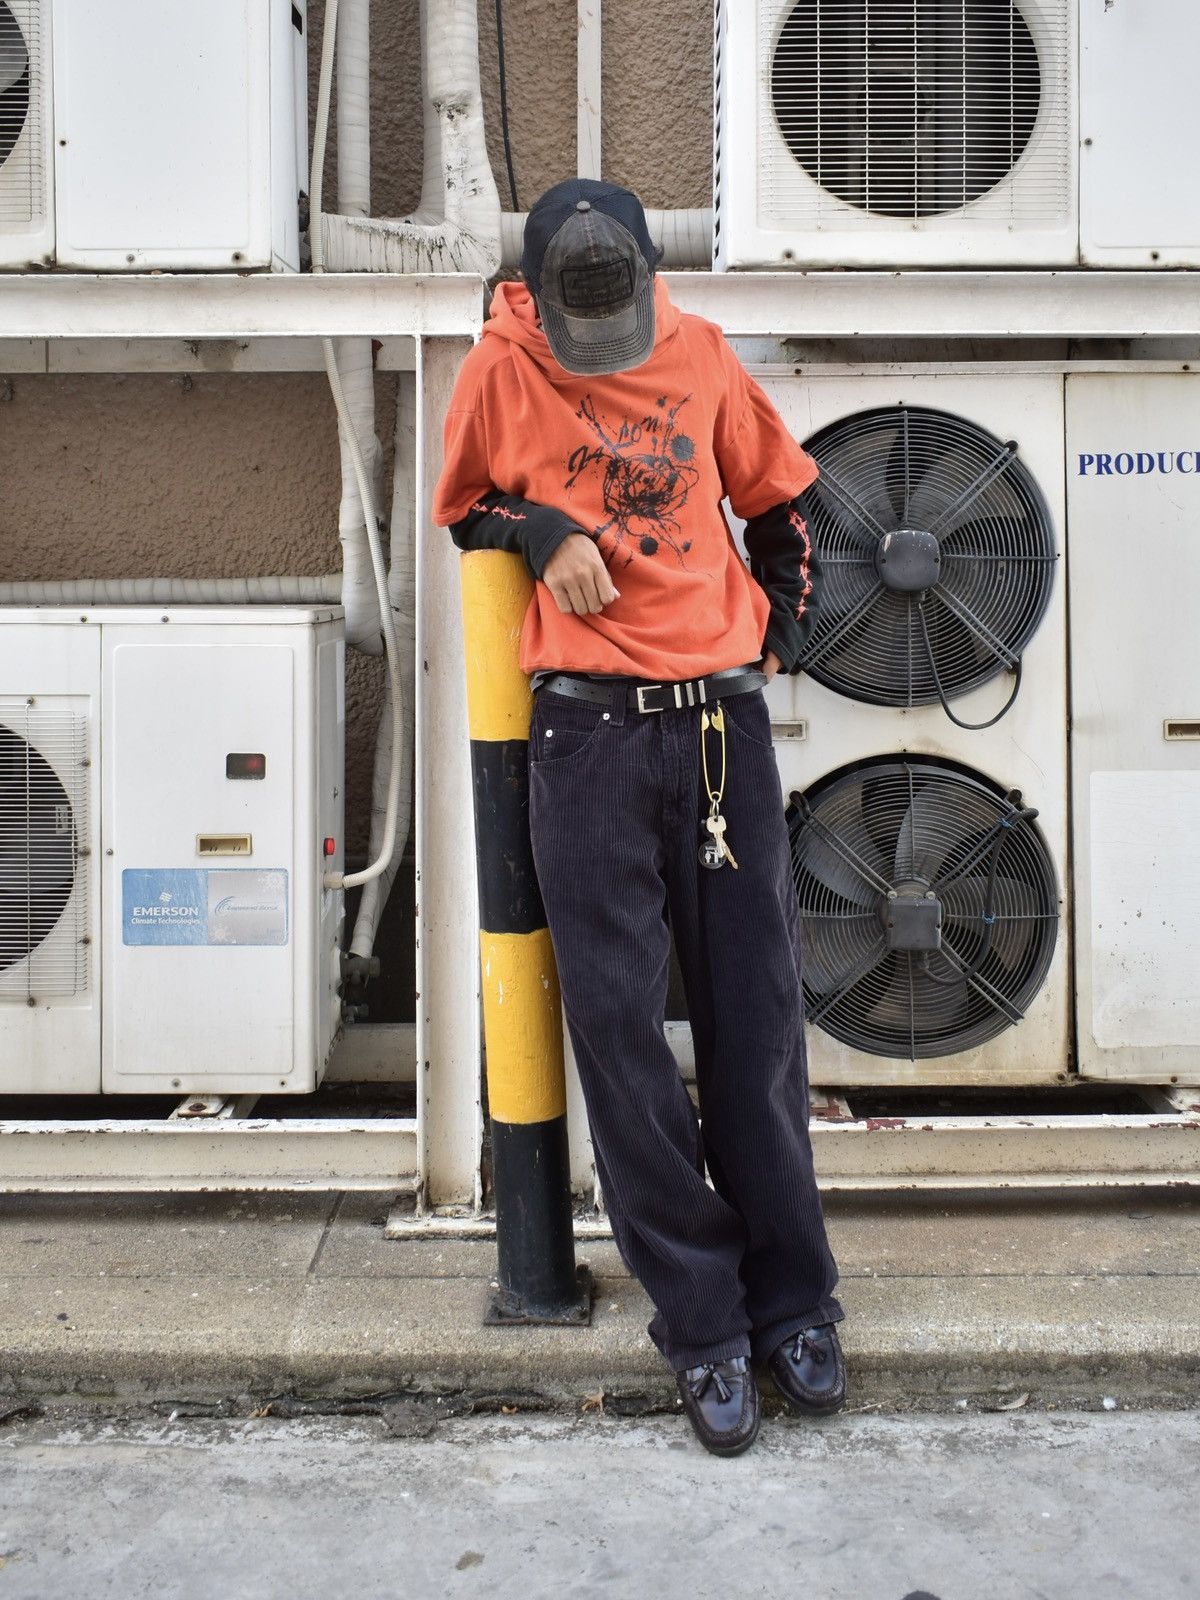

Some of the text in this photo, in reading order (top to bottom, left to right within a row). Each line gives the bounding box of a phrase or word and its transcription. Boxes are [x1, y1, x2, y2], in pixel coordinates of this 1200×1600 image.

[133, 906, 199, 916] EMERSON
[131, 917, 201, 926] Climate Technologies
